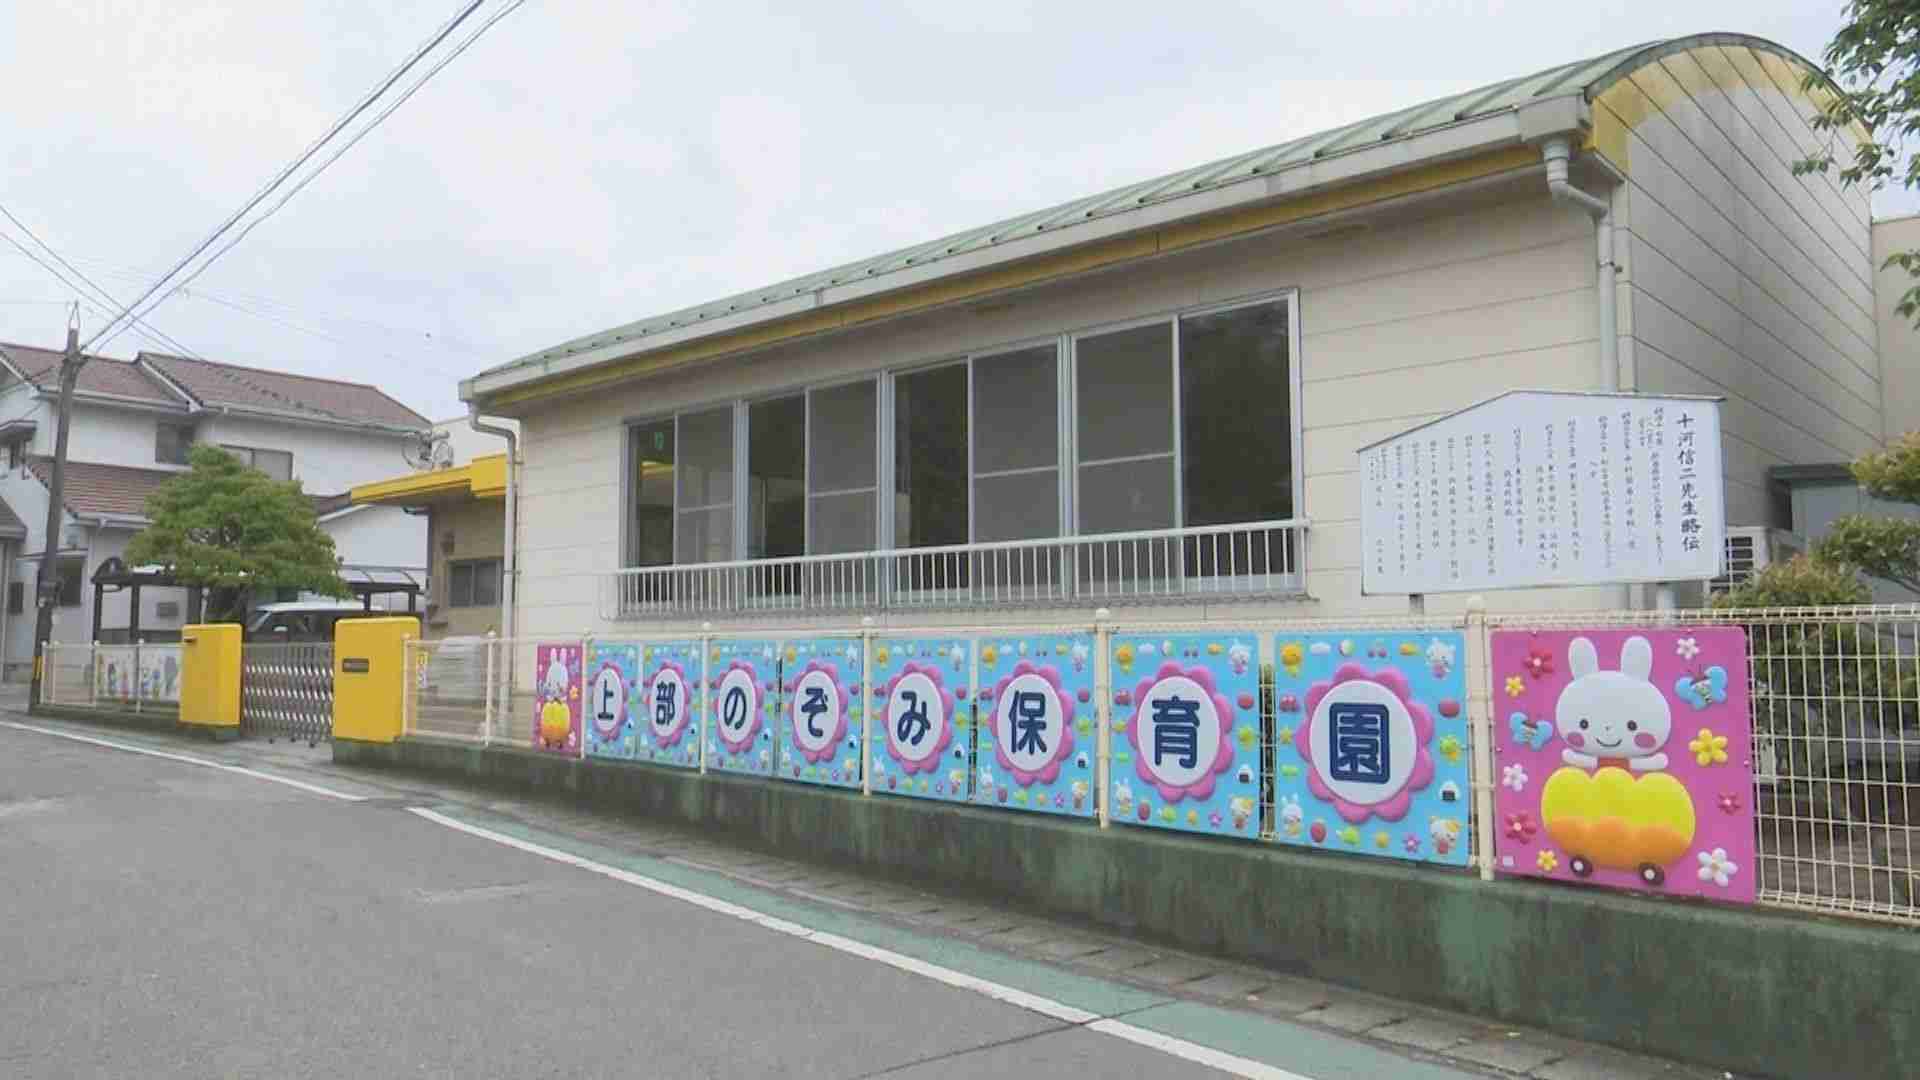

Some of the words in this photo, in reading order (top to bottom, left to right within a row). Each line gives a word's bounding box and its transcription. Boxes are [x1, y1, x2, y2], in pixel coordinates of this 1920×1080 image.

[1677, 412, 1702, 552] 十河信二先生略伝
[597, 679, 1391, 784] 上部のぞみ保育園
